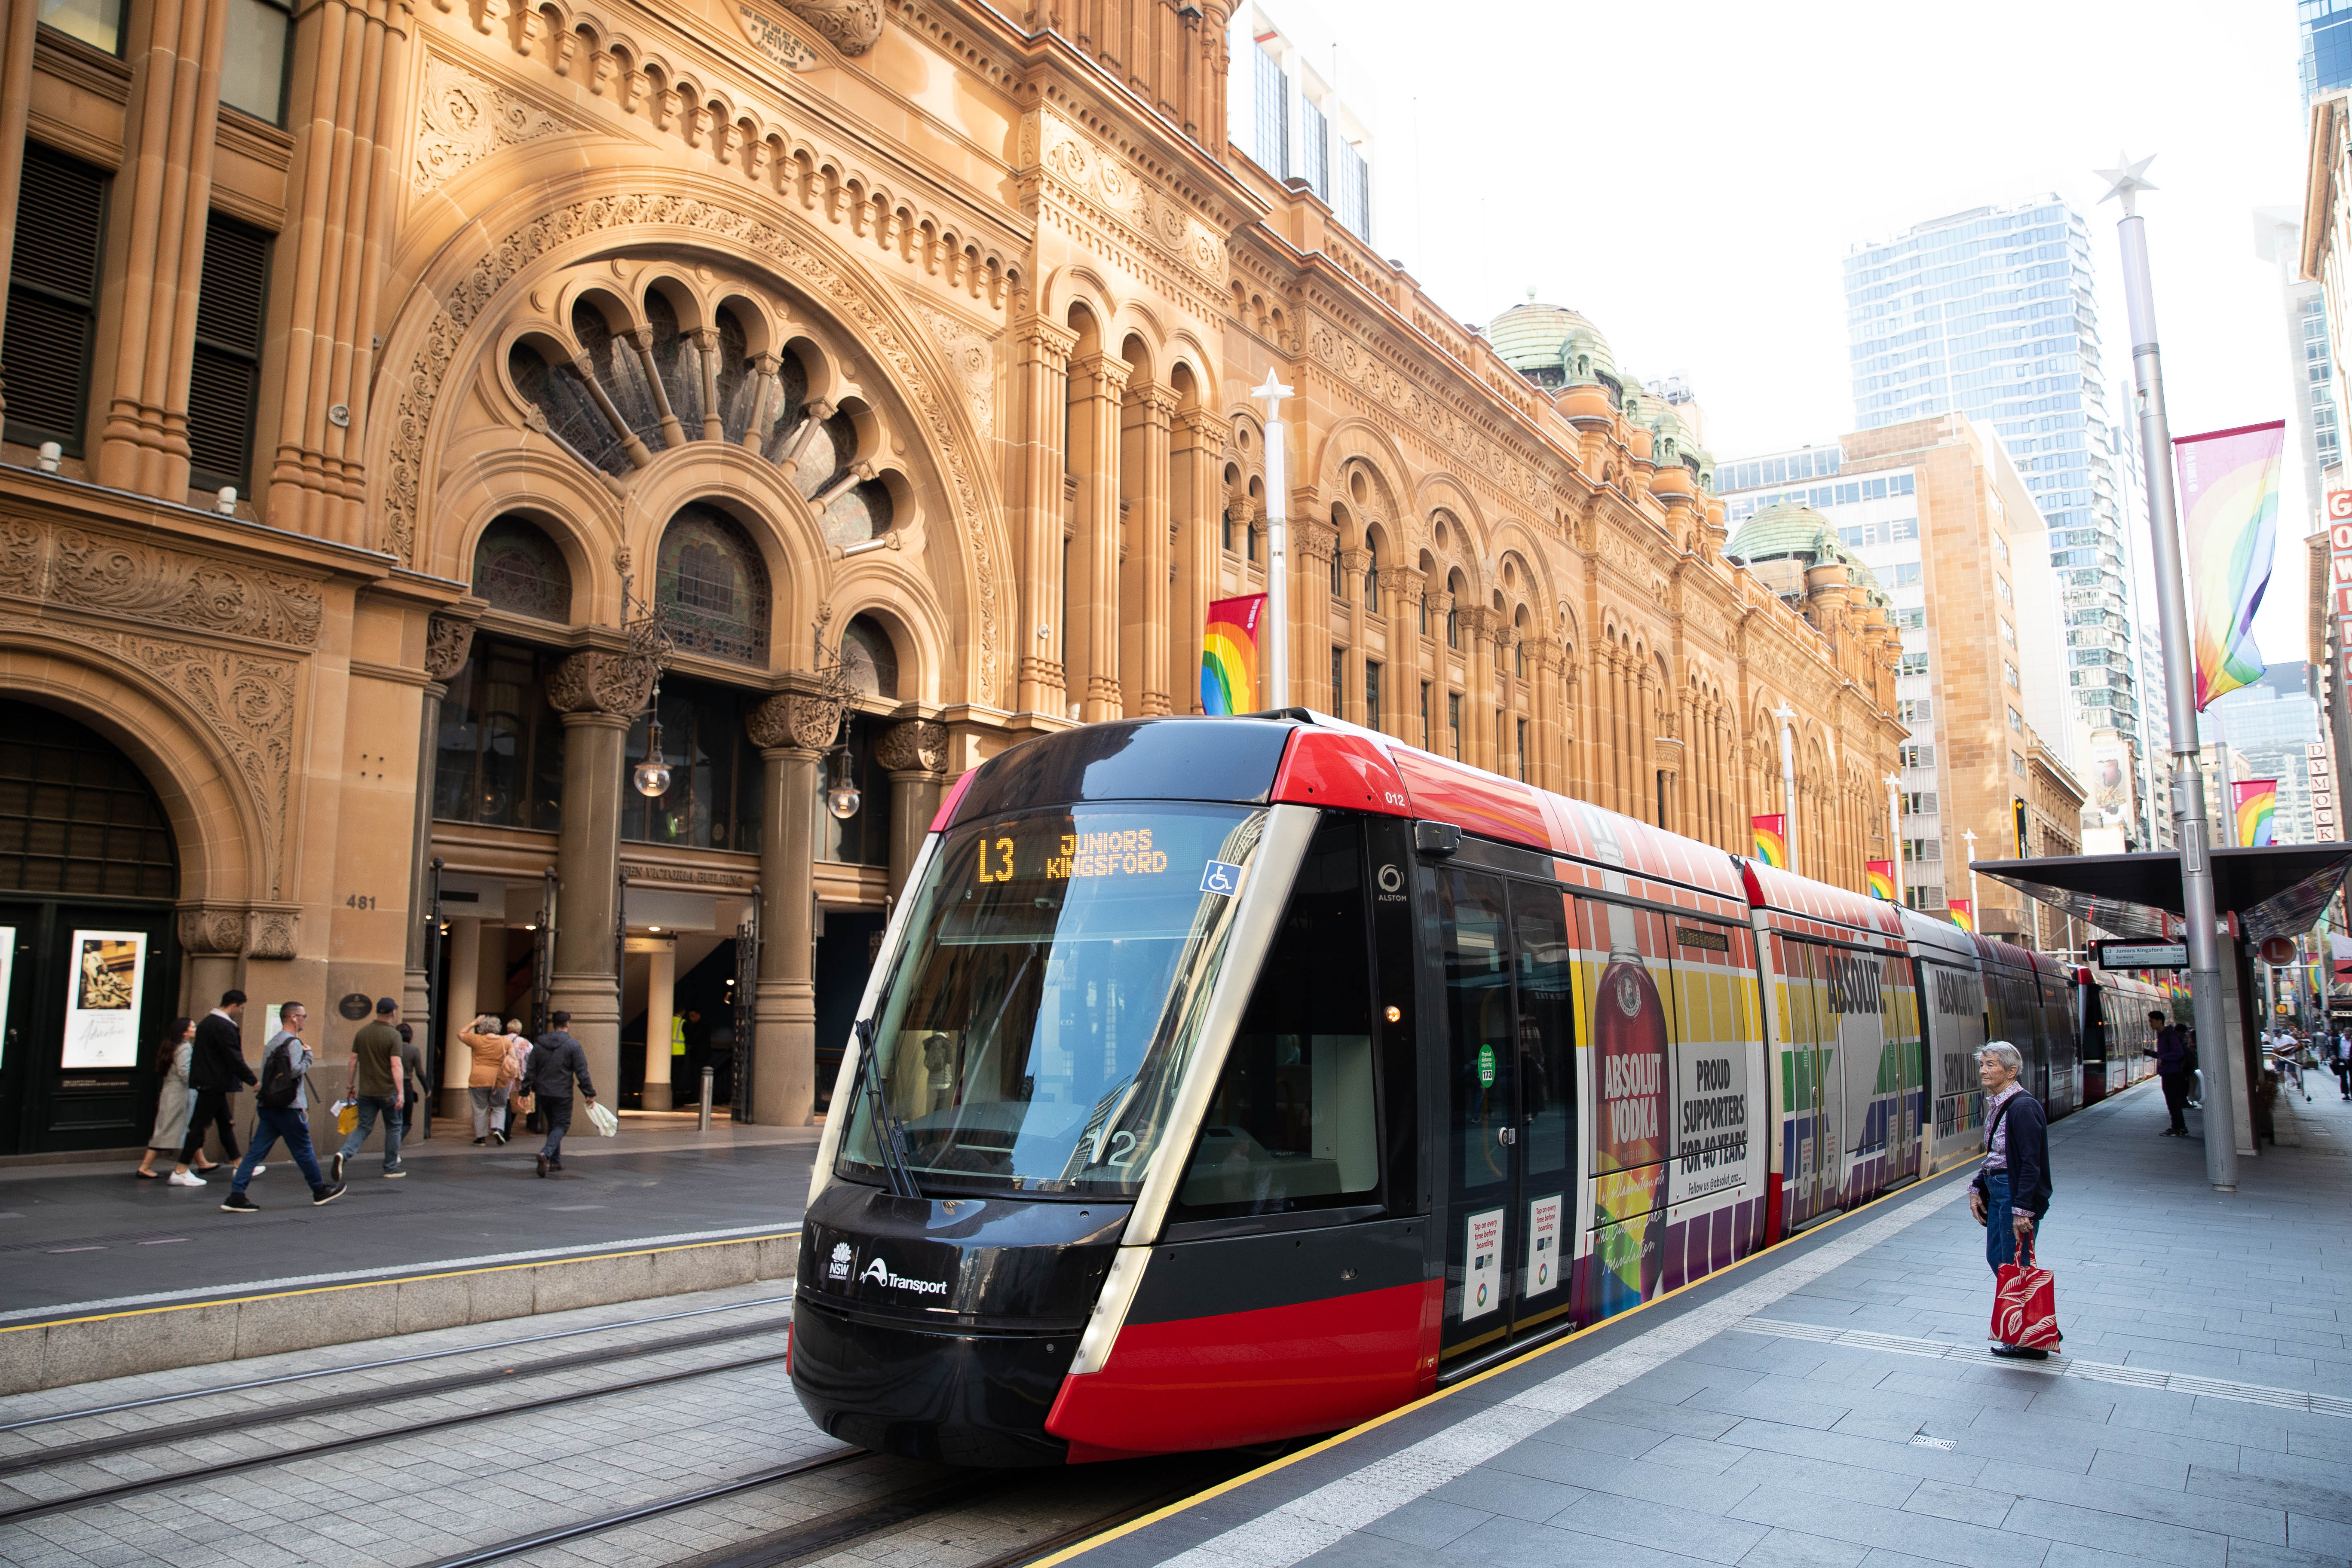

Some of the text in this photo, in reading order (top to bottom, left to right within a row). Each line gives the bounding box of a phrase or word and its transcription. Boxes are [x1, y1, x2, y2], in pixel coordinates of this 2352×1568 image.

[1385, 791, 1406, 807] 012
[1060, 829, 1152, 856] JUNIORS
[979, 838, 1014, 882] L3
[1047, 851, 1167, 879] KINGSFORD
[645, 867, 692, 882] VICTORIA
[697, 872, 743, 886] BUILDING
[346, 894, 376, 910] 481
[2271, 942, 2285, 958] L
[1825, 955, 1886, 1014] ABSOLUT.
[1482, 1071, 1492, 1079] 173
[1605, 1053, 1661, 1099] ABSOLUT
[1696, 1059, 1730, 1092] PROUD
[1945, 1053, 1964, 1093] SHOW
[1611, 1096, 1659, 1144] VODKA
[1683, 1094, 1744, 1134] SUPPORTERS
[1936, 1091, 1984, 1140] YOUR COLOURS
[1086, 1129, 1136, 1167] 12
[1681, 1130, 1746, 1175] FOR 40 YEARS
[1688, 1173, 1739, 1195] Follow us @absolut_anz
[1487, 1219, 1498, 1228] every
[1538, 1222, 1553, 1232] boarding
[1544, 1213, 1555, 1222] before
[1476, 1239, 1494, 1250] boarding
[1484, 1229, 1496, 1238] before
[829, 1262, 850, 1276] NSW
[888, 1273, 947, 1295] Transport
